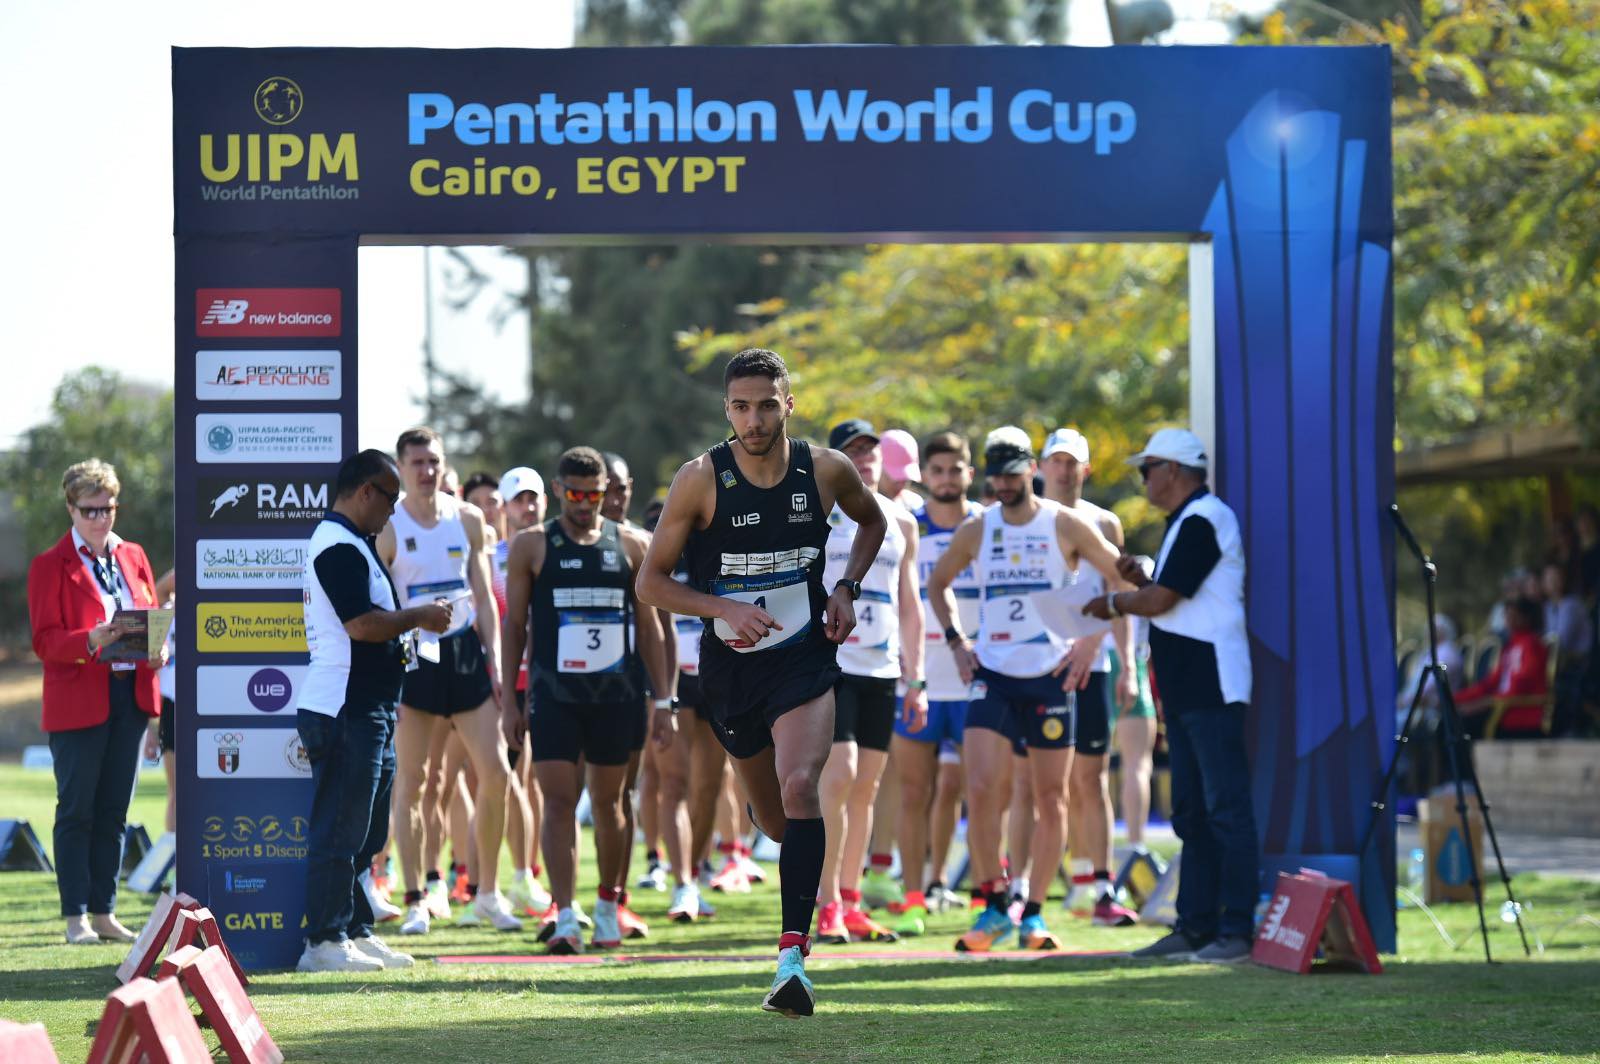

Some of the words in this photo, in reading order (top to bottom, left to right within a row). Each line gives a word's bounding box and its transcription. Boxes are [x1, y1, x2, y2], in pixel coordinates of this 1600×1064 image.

[408, 87, 777, 145] Pentathlon
[793, 86, 993, 143] World
[1008, 89, 1137, 154] Cup
[200, 132, 359, 183] UIPM
[409, 157, 558, 200] Cairo,
[577, 155, 746, 194] EGYPT
[201, 184, 256, 201] World
[260, 184, 359, 200] Pentathlon
[250, 314, 275, 325] new
[278, 312, 332, 325] balance
[246, 365, 328, 375] ABSOLUTE
[246, 374, 330, 386] FENCING
[261, 426, 315, 434] ASIA-PACIFIC
[238, 436, 299, 444] DEVELOPMENT
[300, 436, 333, 444] CENTRE
[257, 483, 328, 509] RAM
[257, 511, 285, 519] SWISS
[203, 571, 241, 579] NATIONAL
[243, 571, 264, 579] BANK
[266, 571, 276, 579] OF
[989, 568, 1047, 581] FRANCE
[860, 605, 873, 625] 4
[1009, 599, 1025, 621] 2
[230, 615, 252, 625] The
[256, 615, 305, 625] America
[229, 627, 289, 640] University
[291, 627, 302, 638] in
[587, 628, 601, 650] 3
[202, 844, 211, 858] 1
[214, 844, 250, 859] Sport
[253, 844, 263, 857] 5
[266, 844, 309, 859] Discip
[224, 911, 284, 930] GATE
